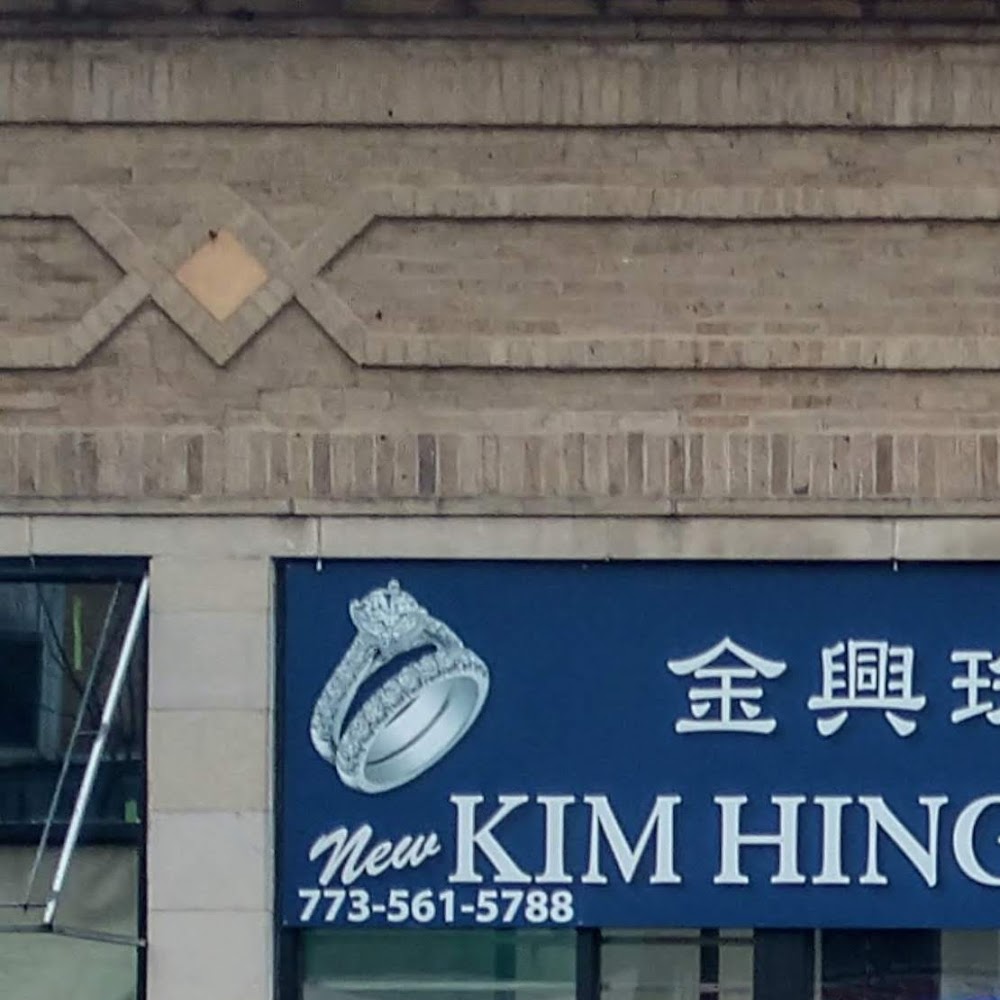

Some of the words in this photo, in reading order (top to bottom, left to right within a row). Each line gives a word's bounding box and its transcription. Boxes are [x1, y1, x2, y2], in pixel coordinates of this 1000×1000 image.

[308, 824, 442, 886] New
[448, 794, 683, 884] KIM
[298, 889, 575, 923] 773-561-5788
